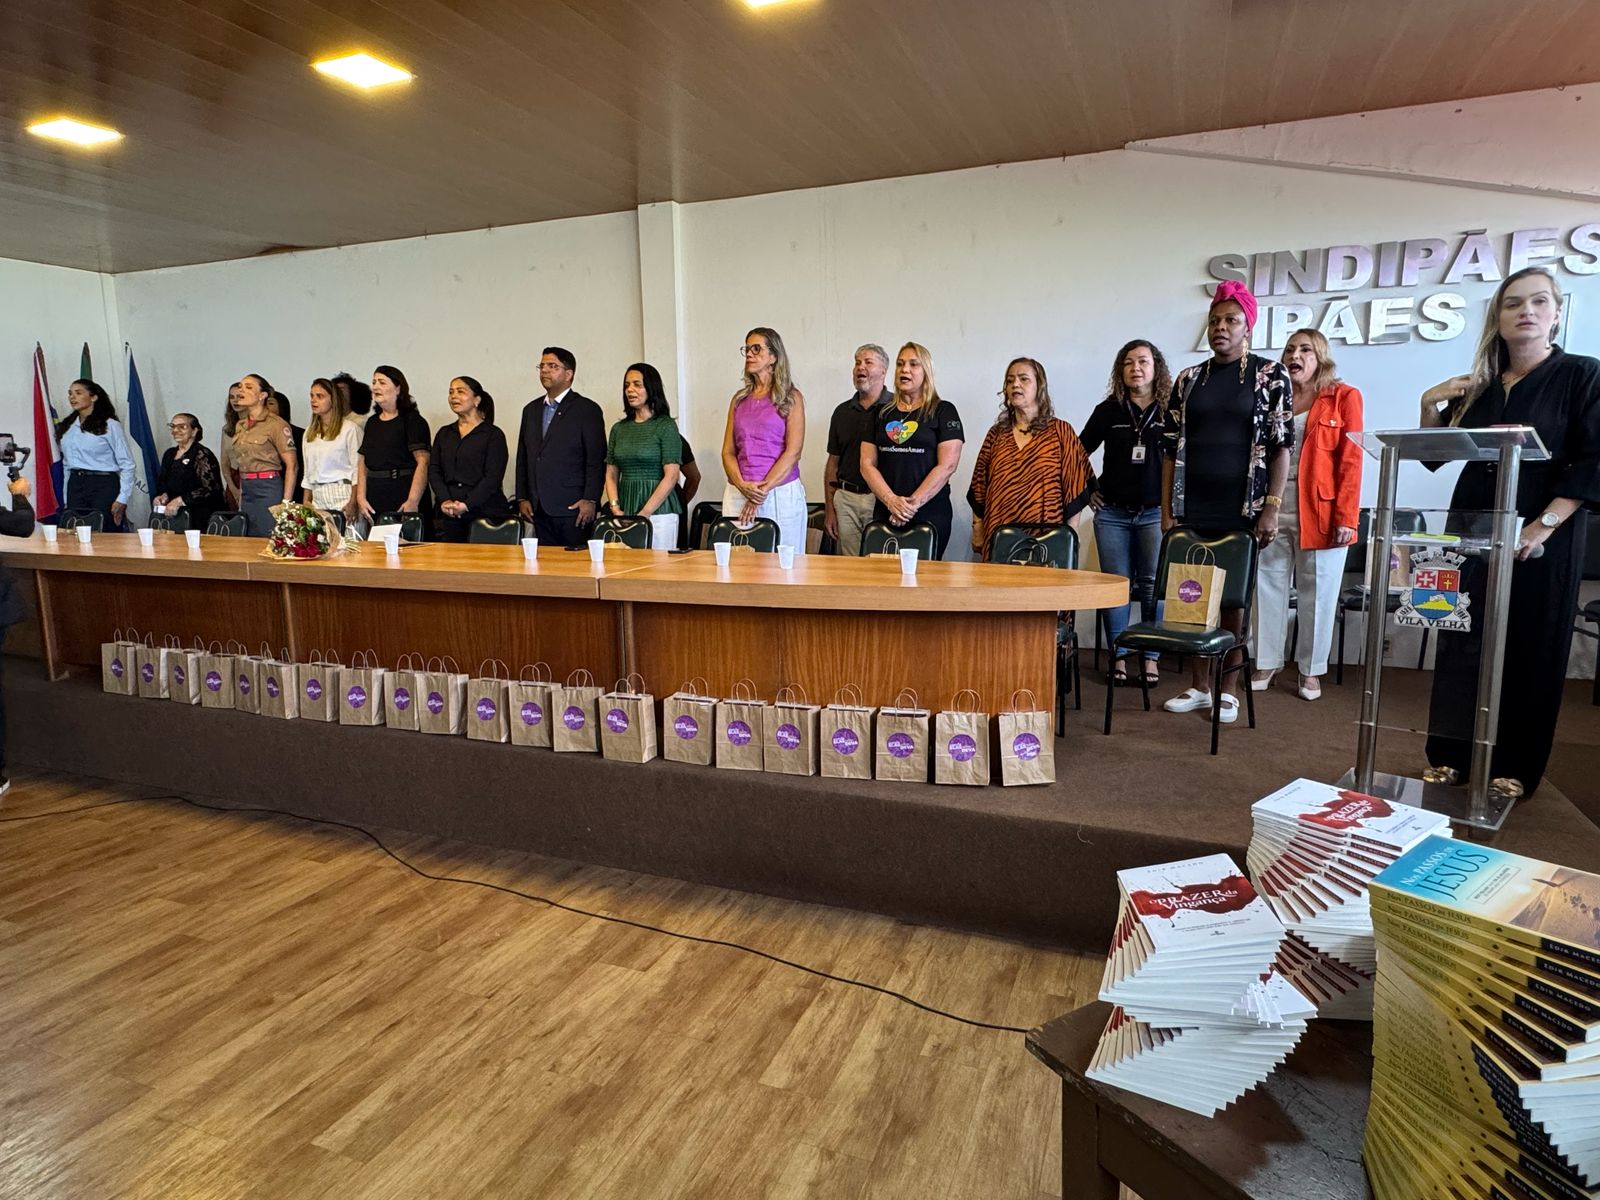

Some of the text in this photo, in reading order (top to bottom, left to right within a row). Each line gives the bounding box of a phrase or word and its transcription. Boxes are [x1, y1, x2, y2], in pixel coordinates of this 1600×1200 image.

[1196, 292, 1467, 352] IPÃES
[1398, 616, 1467, 630] VILA VELHA
[1413, 851, 1448, 875] PASSOS
[1415, 849, 1490, 901] JESUS
[1155, 889, 1227, 906] PRAZER
[1162, 896, 1227, 910] Vingança
[1404, 897, 1436, 913] PASSOS
[1448, 911, 1472, 924] JESUS
